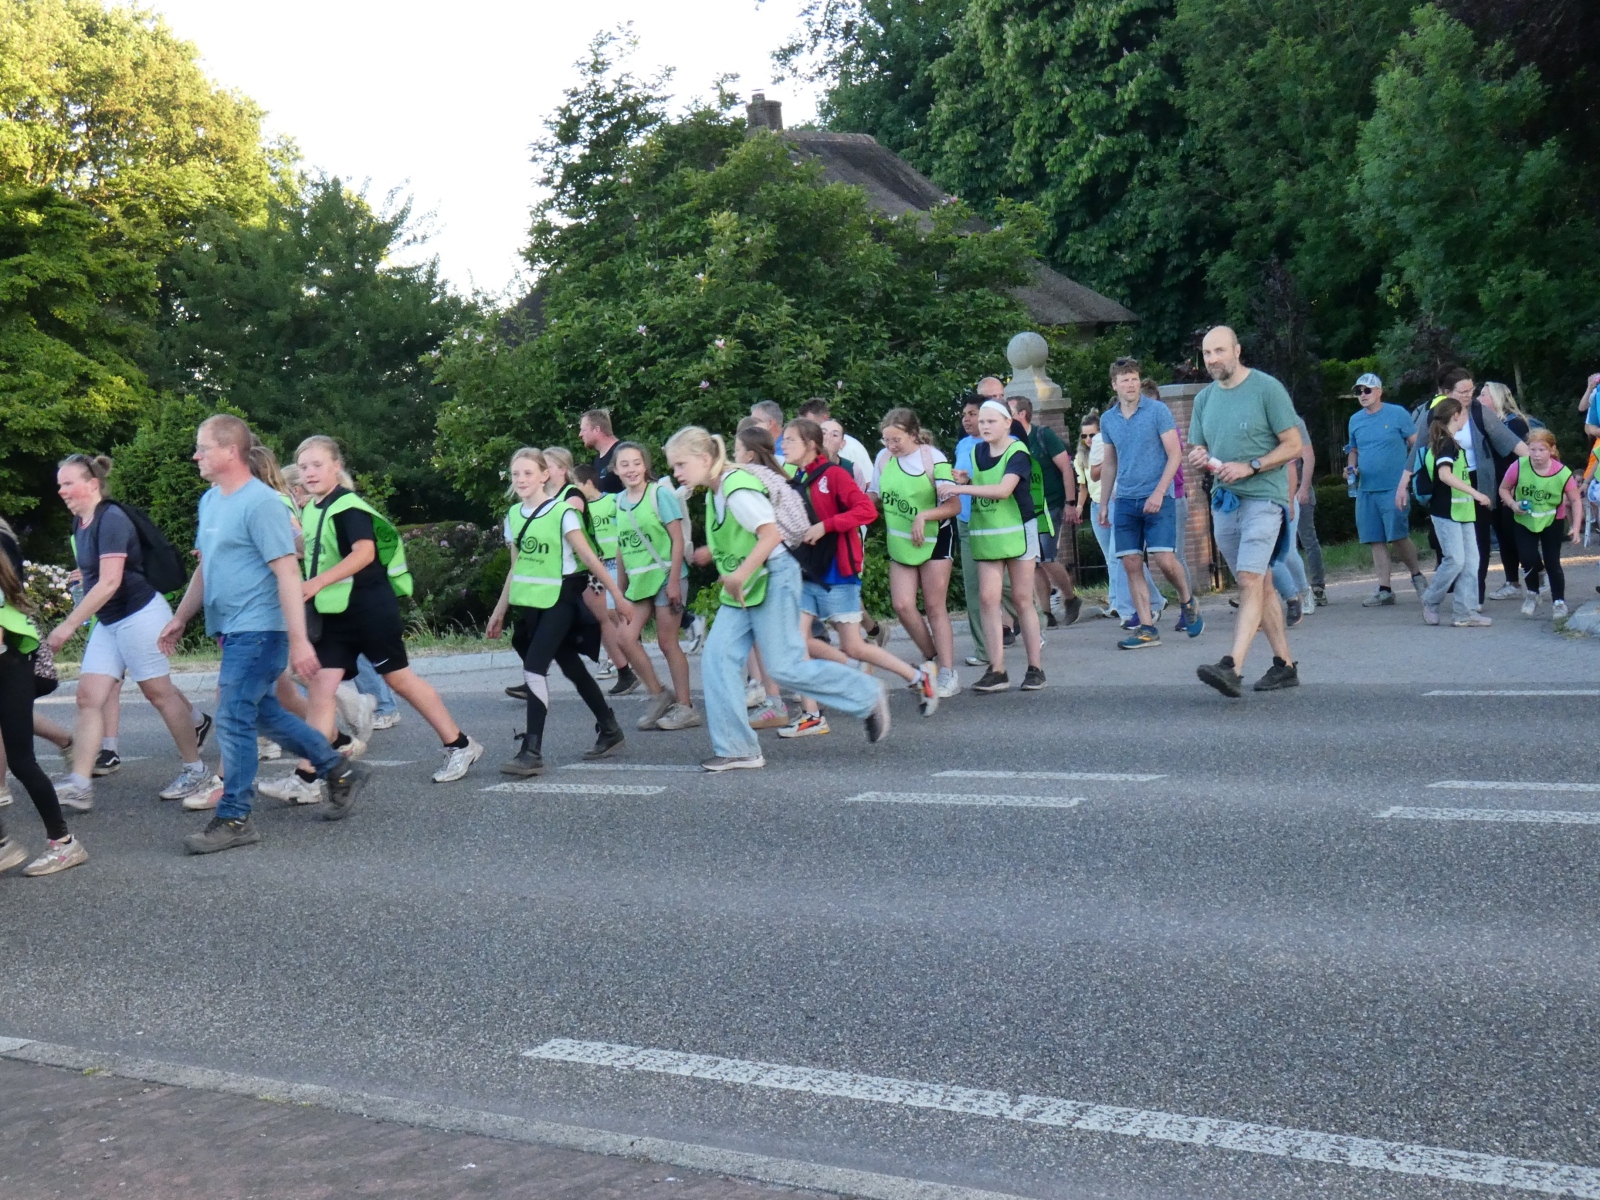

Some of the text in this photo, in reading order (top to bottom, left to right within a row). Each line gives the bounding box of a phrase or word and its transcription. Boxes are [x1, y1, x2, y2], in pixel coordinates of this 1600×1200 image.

[882, 491, 918, 516] Bron
[1522, 486, 1552, 502] Bron
[520, 536, 549, 555] on
